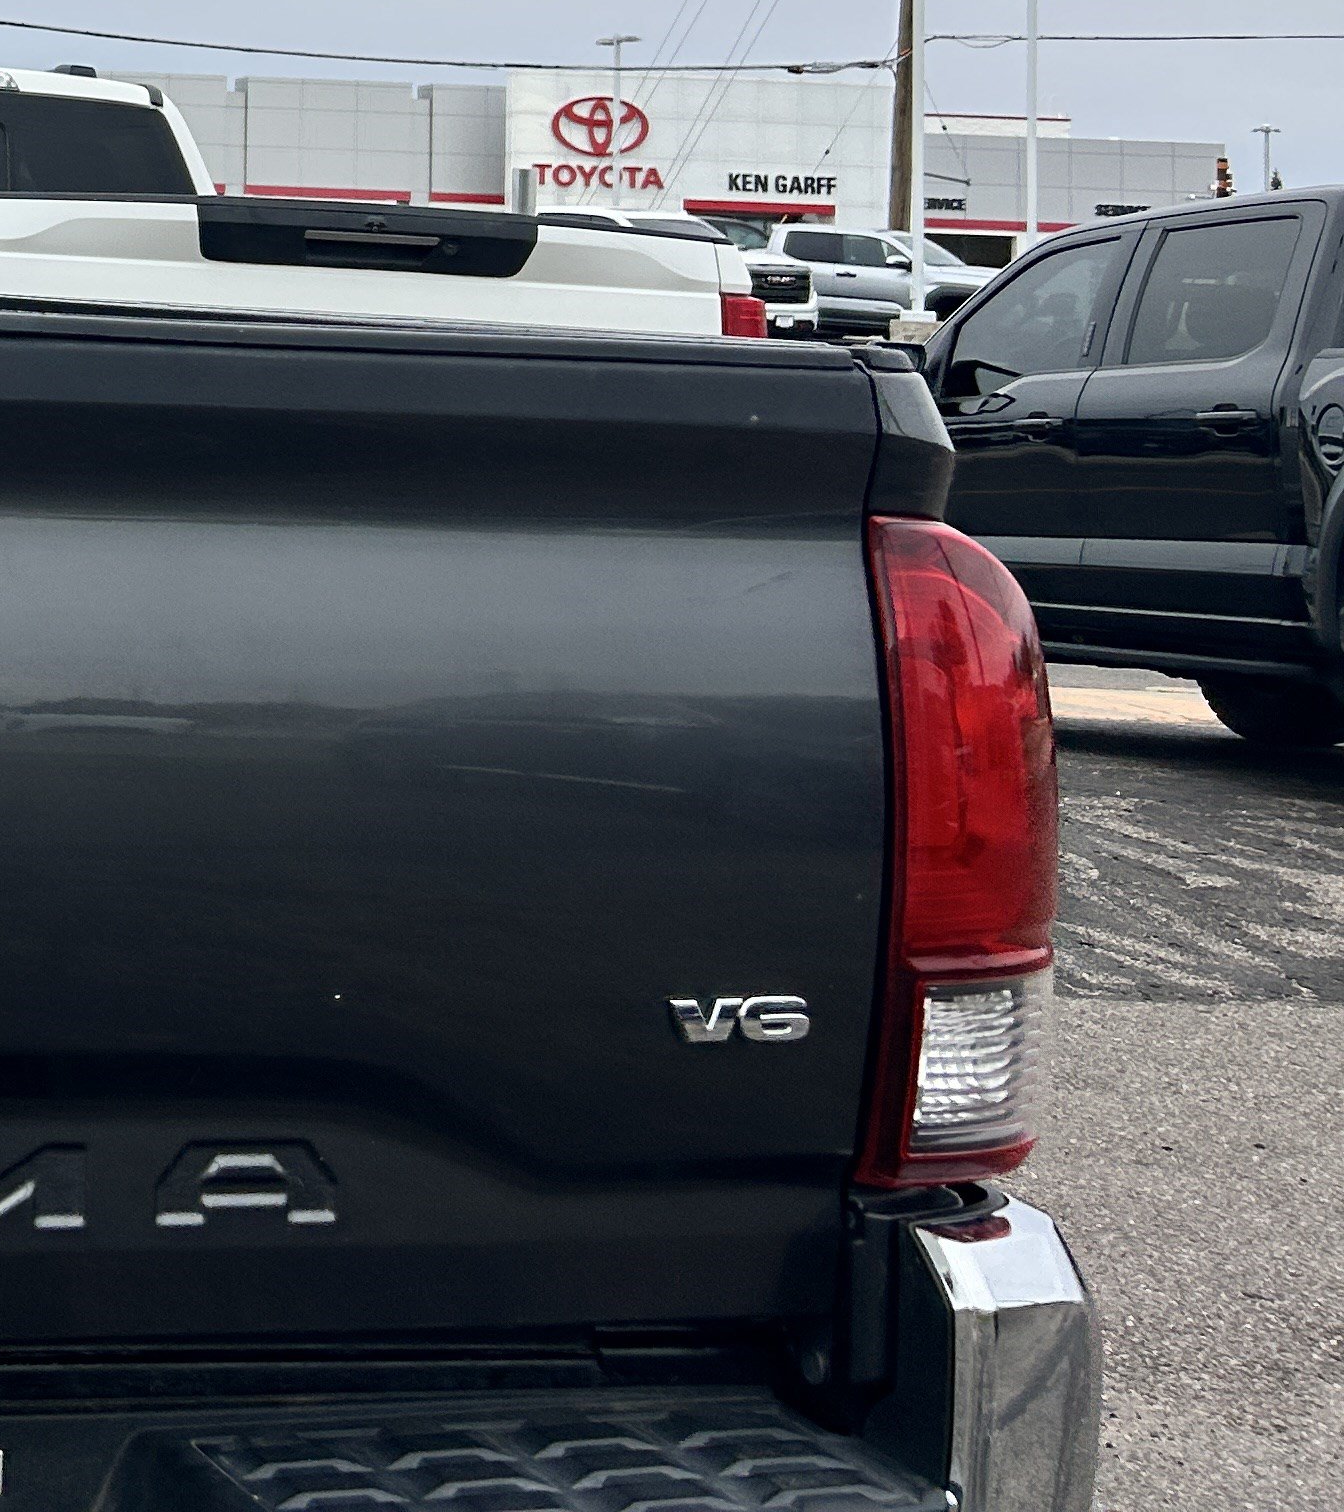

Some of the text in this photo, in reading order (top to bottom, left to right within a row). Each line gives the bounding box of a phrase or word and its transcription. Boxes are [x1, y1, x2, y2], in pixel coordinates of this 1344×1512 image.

[531, 163, 665, 190] TOYOTA
[728, 172, 838, 195] KEN GARFF
[669, 995, 811, 1042] V6
